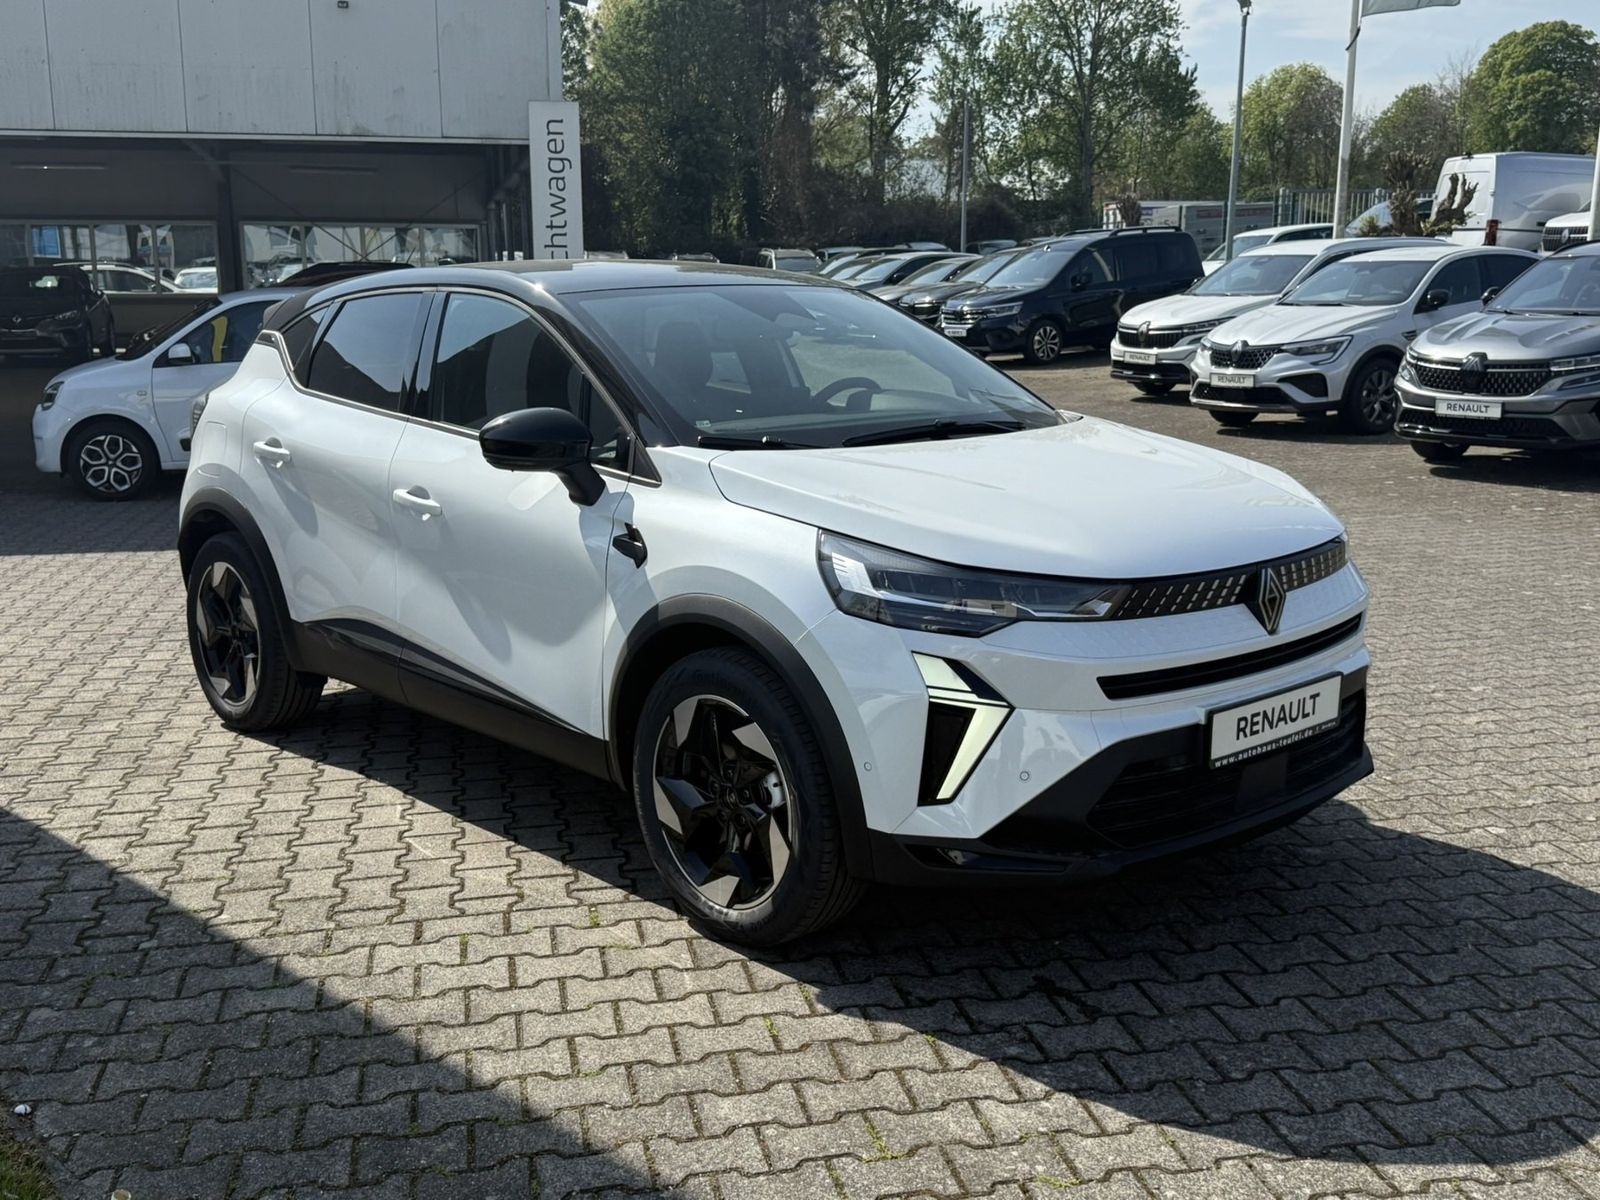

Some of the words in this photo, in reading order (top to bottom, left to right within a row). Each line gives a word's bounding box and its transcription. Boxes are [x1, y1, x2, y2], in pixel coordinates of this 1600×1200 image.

[1128, 354, 1151, 362] RENAULT
[1217, 375, 1248, 385] RENAULT
[1446, 403, 1491, 414] RENAULT
[1235, 692, 1321, 741] RENAULT
[1214, 729, 1313, 768] www.autohaus-teufel.de
